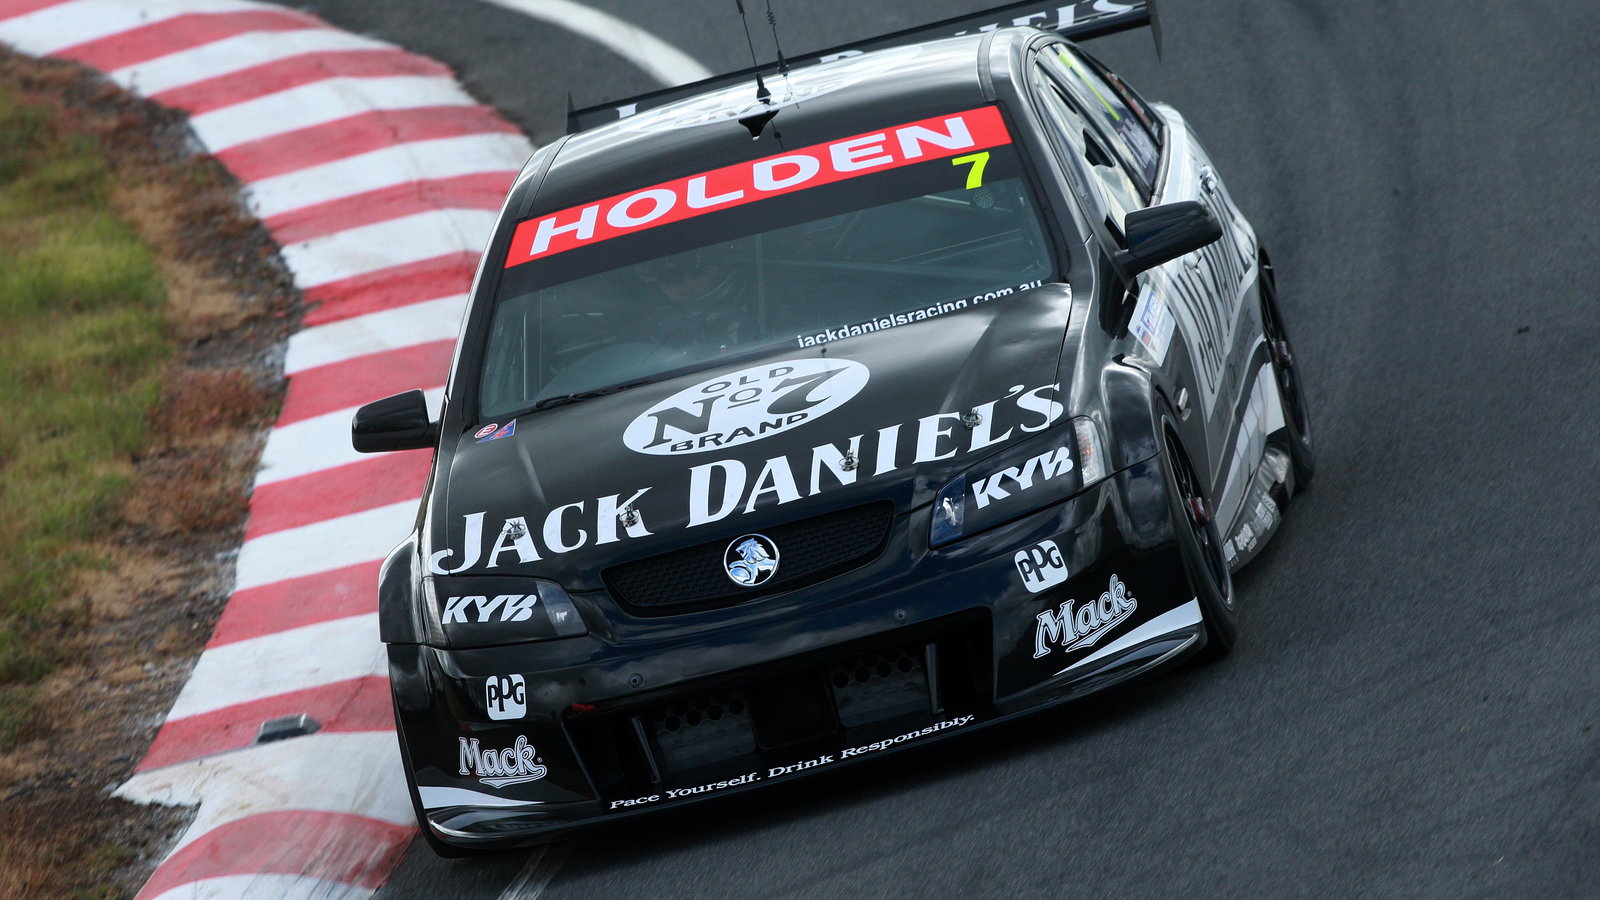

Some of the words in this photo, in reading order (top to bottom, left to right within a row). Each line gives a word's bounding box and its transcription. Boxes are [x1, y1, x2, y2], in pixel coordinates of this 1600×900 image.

[529, 116, 976, 256] HOLDEN
[951, 151, 990, 190] 7
[701, 366, 795, 394] OLD
[766, 366, 862, 415] 7
[670, 412, 809, 453] BRAND
[431, 487, 655, 576] JACK
[685, 383, 1064, 529] DANIEL'S
[971, 446, 1074, 510] KYB
[442, 594, 538, 626] KYB
[609, 793, 660, 810] Pace
[666, 773, 762, 801] Yourself.
[767, 754, 834, 779] Drink
[840, 713, 976, 760] Responsibly.
